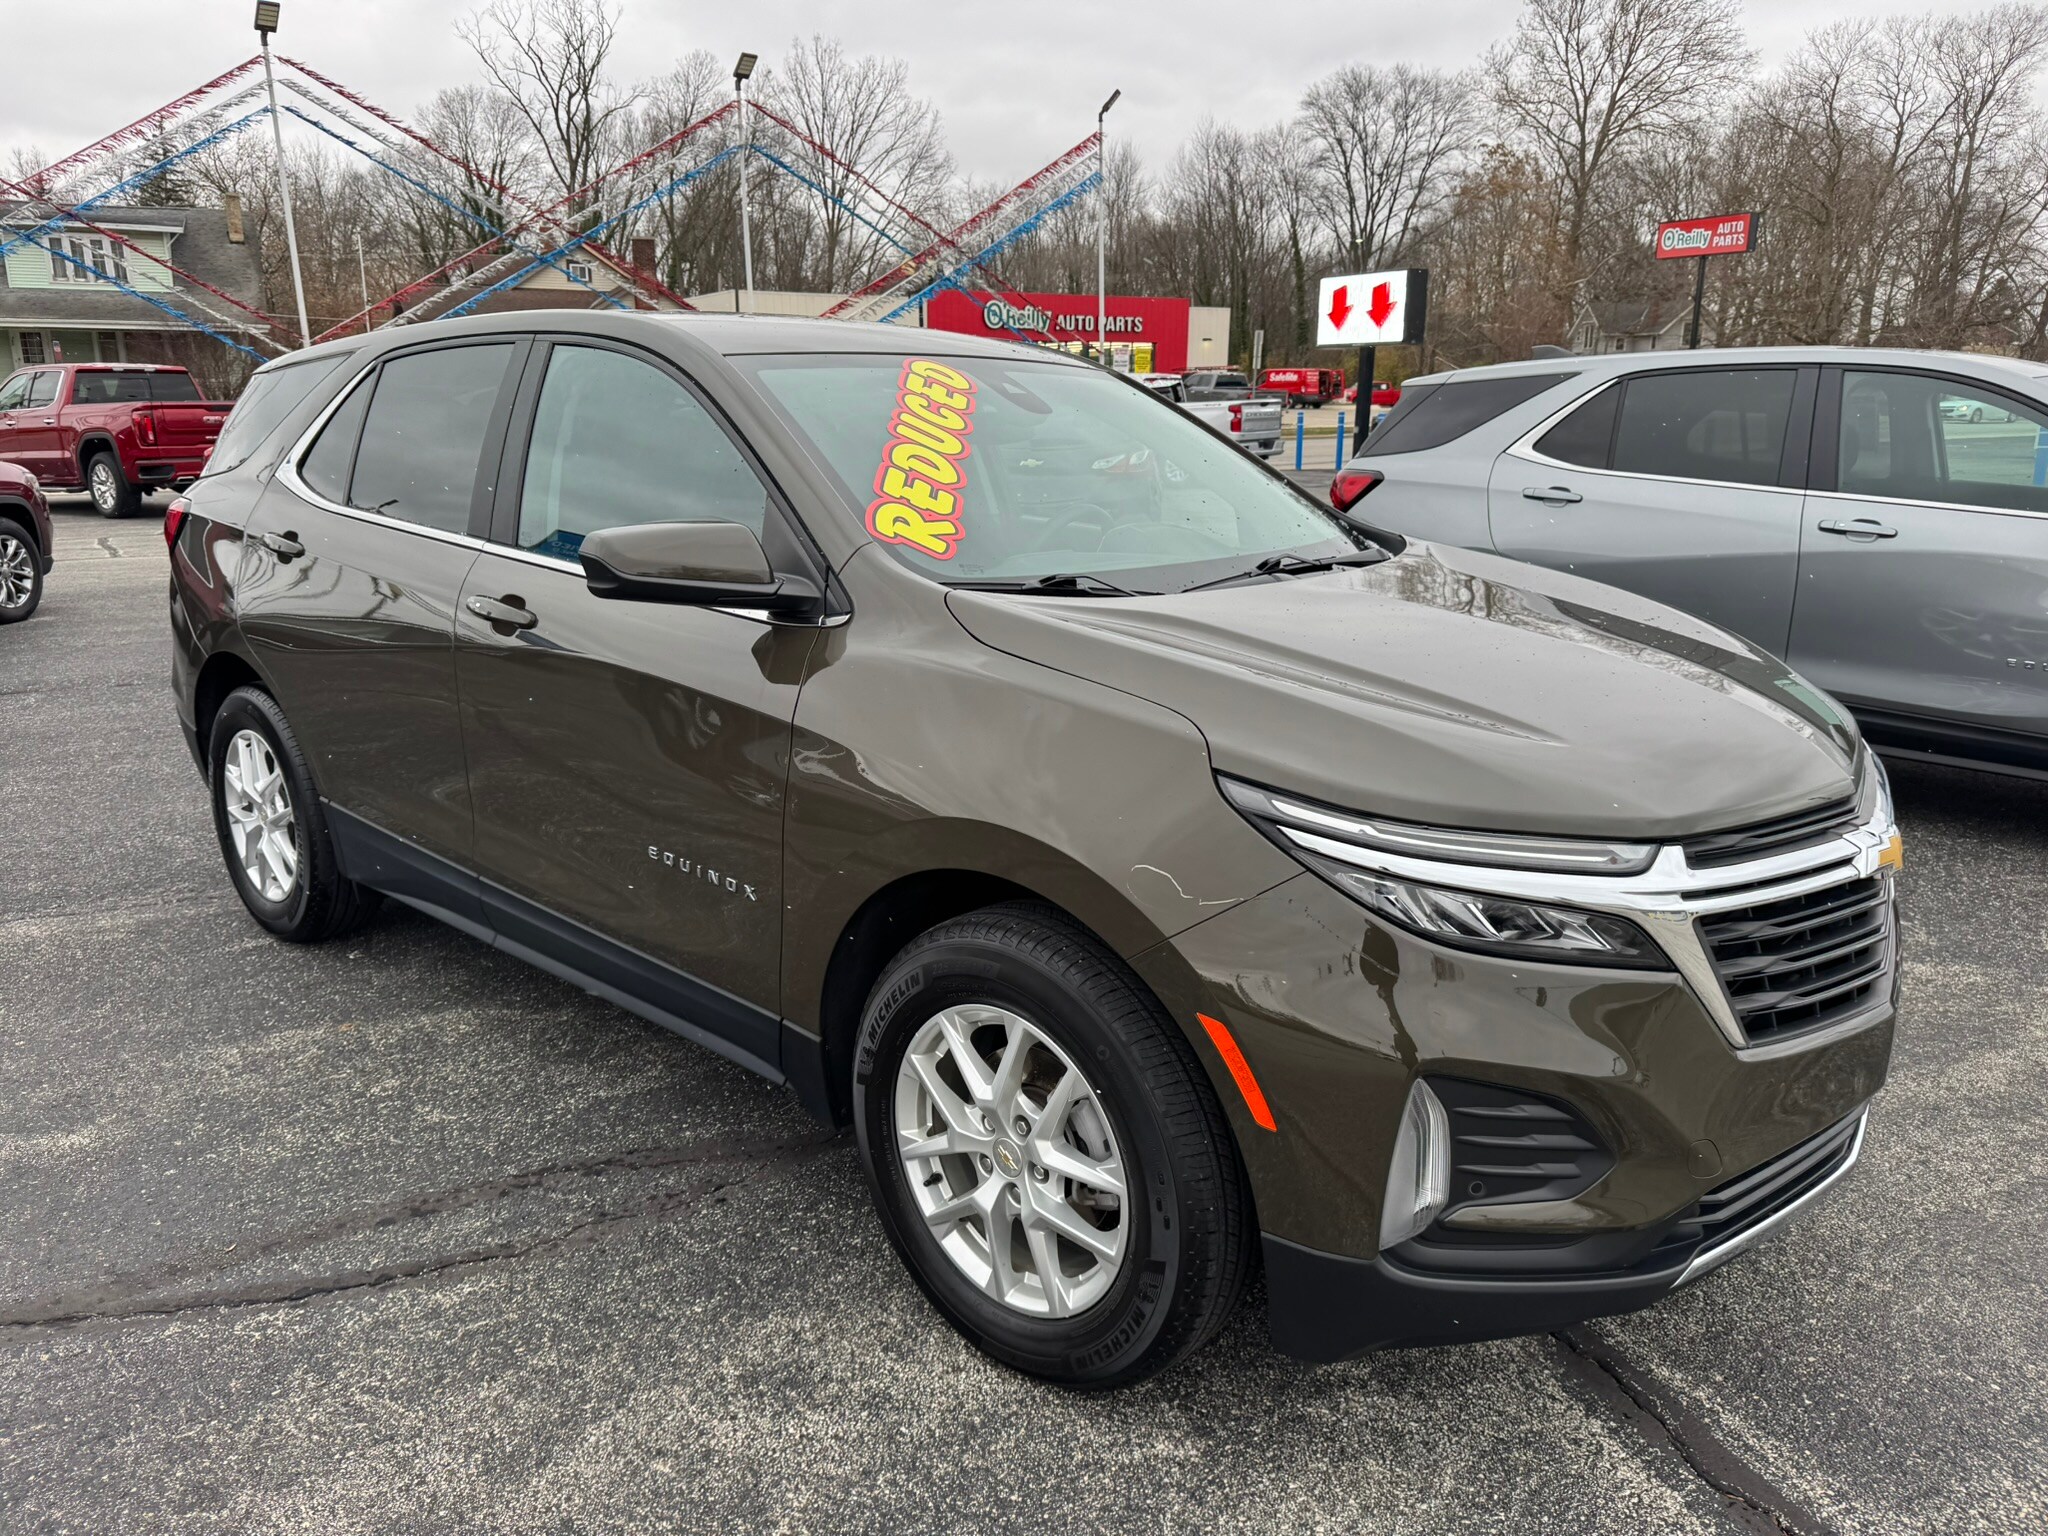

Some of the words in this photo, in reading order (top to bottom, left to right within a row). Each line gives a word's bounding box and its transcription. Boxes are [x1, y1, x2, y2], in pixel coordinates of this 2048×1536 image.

[1662, 229, 1710, 249] O'Reilly
[1712, 234, 1745, 247] PARTS
[1717, 221, 1744, 234] AUTO
[984, 300, 1051, 333] O'Reilly
[1056, 315, 1094, 331] AUTO
[869, 358, 977, 559] REDUCED
[648, 846, 757, 901] EQUINOX
[868, 972, 921, 1044] MICHELIN
[1075, 1304, 1146, 1369] MICHELIN
